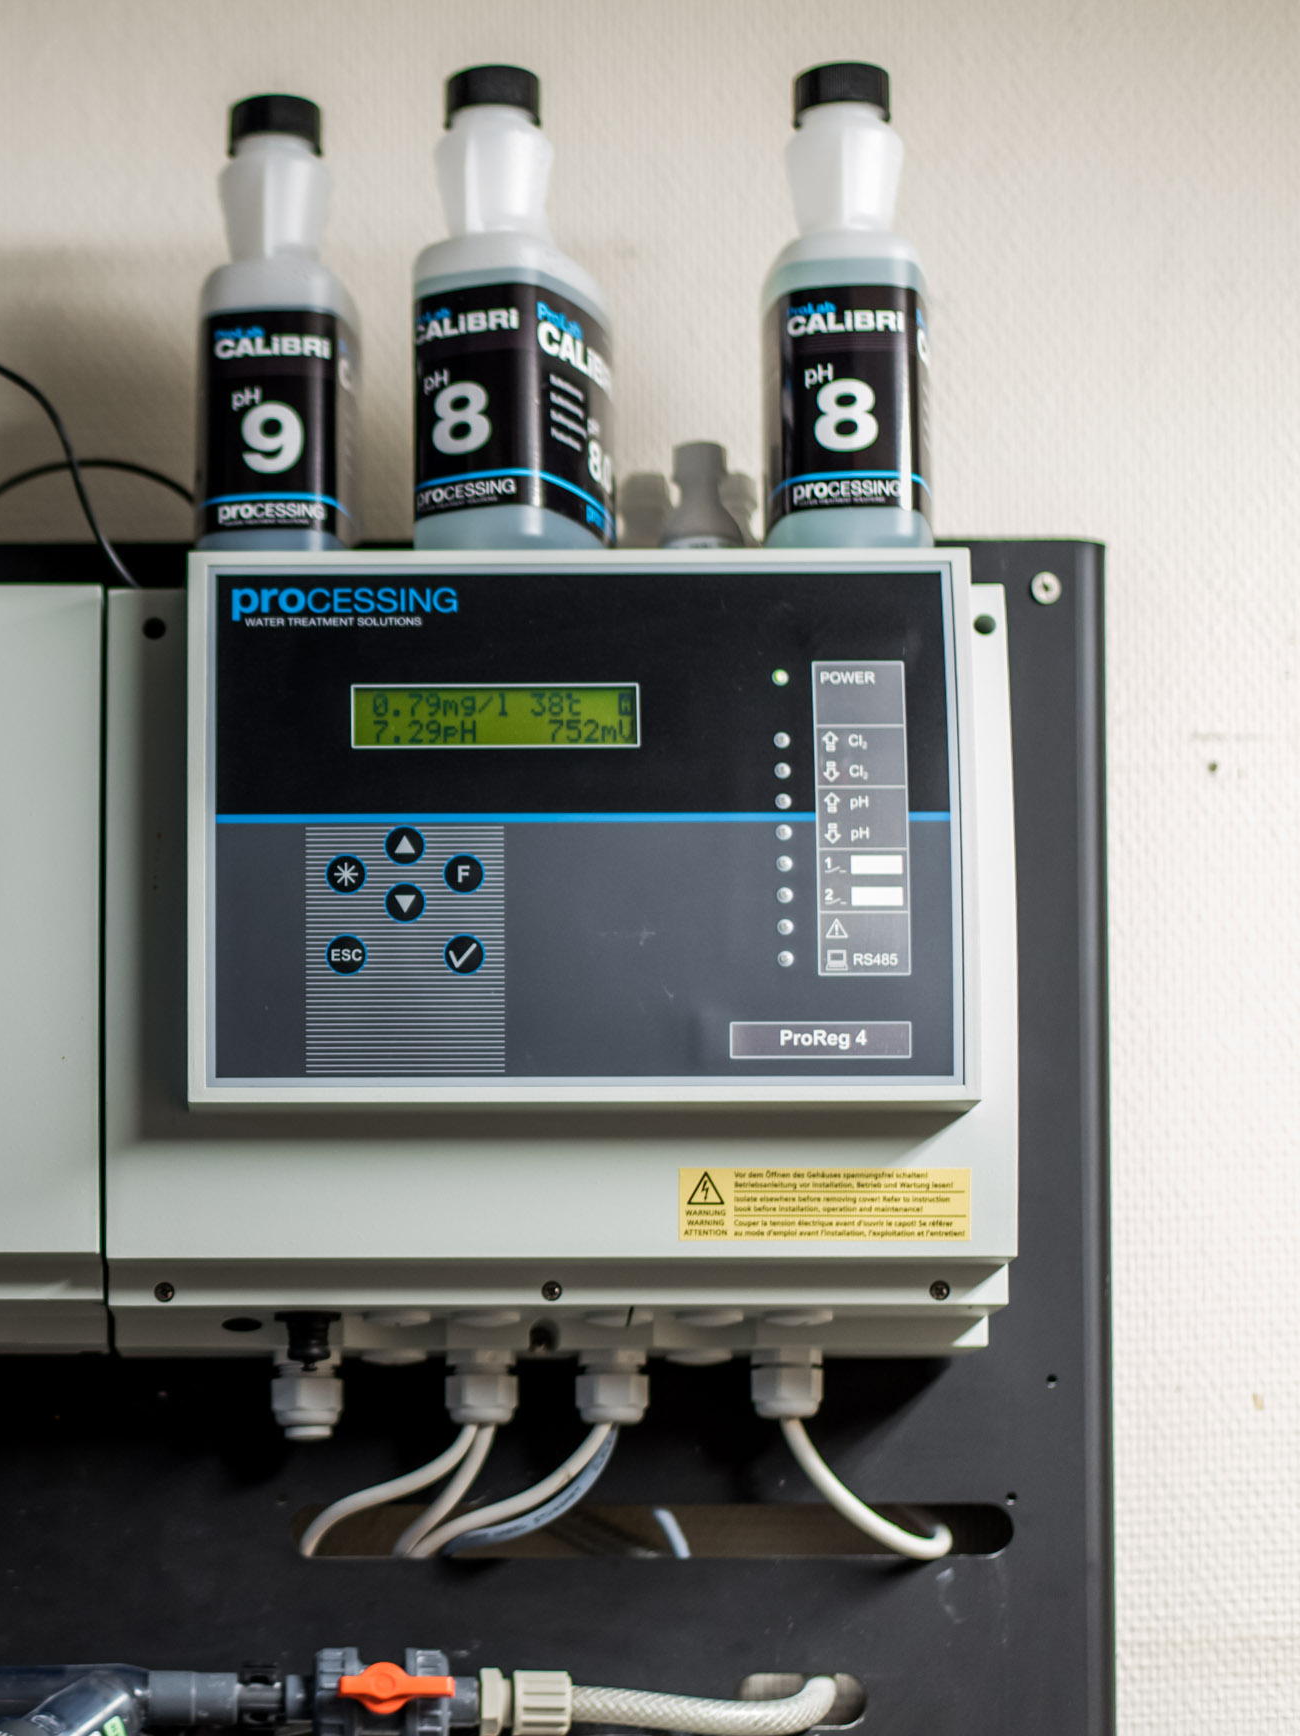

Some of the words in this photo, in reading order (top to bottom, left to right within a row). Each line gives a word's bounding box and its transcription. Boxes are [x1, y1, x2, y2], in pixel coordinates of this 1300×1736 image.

[423, 367, 450, 396] pH
[804, 363, 834, 389] pH
[231, 386, 262, 411] pH
[431, 381, 492, 455] 8
[814, 378, 879, 452] 8
[241, 401, 305, 474] 9
[231, 587, 459, 622] proCESSING
[244, 616, 285, 628] WATER
[288, 616, 355, 627] TREATMENT
[357, 616, 423, 627] SOLUTIONS
[819, 671, 876, 685] POWER
[373, 719, 477, 743] 7.29pH
[850, 795, 869, 811] pH
[850, 826, 870, 842] pH
[824, 856, 832, 869] 1
[457, 865, 470, 883] F
[824, 888, 834, 901] 2
[330, 948, 363, 962] ESC
[853, 953, 898, 966] RS485
[779, 1029, 850, 1050] ProReg
[855, 1029, 868, 1046] 4
[685, 1209, 726, 1217] WARNUNG
[687, 1219, 724, 1227] WARNING
[684, 1229, 728, 1237] ATTENTION
